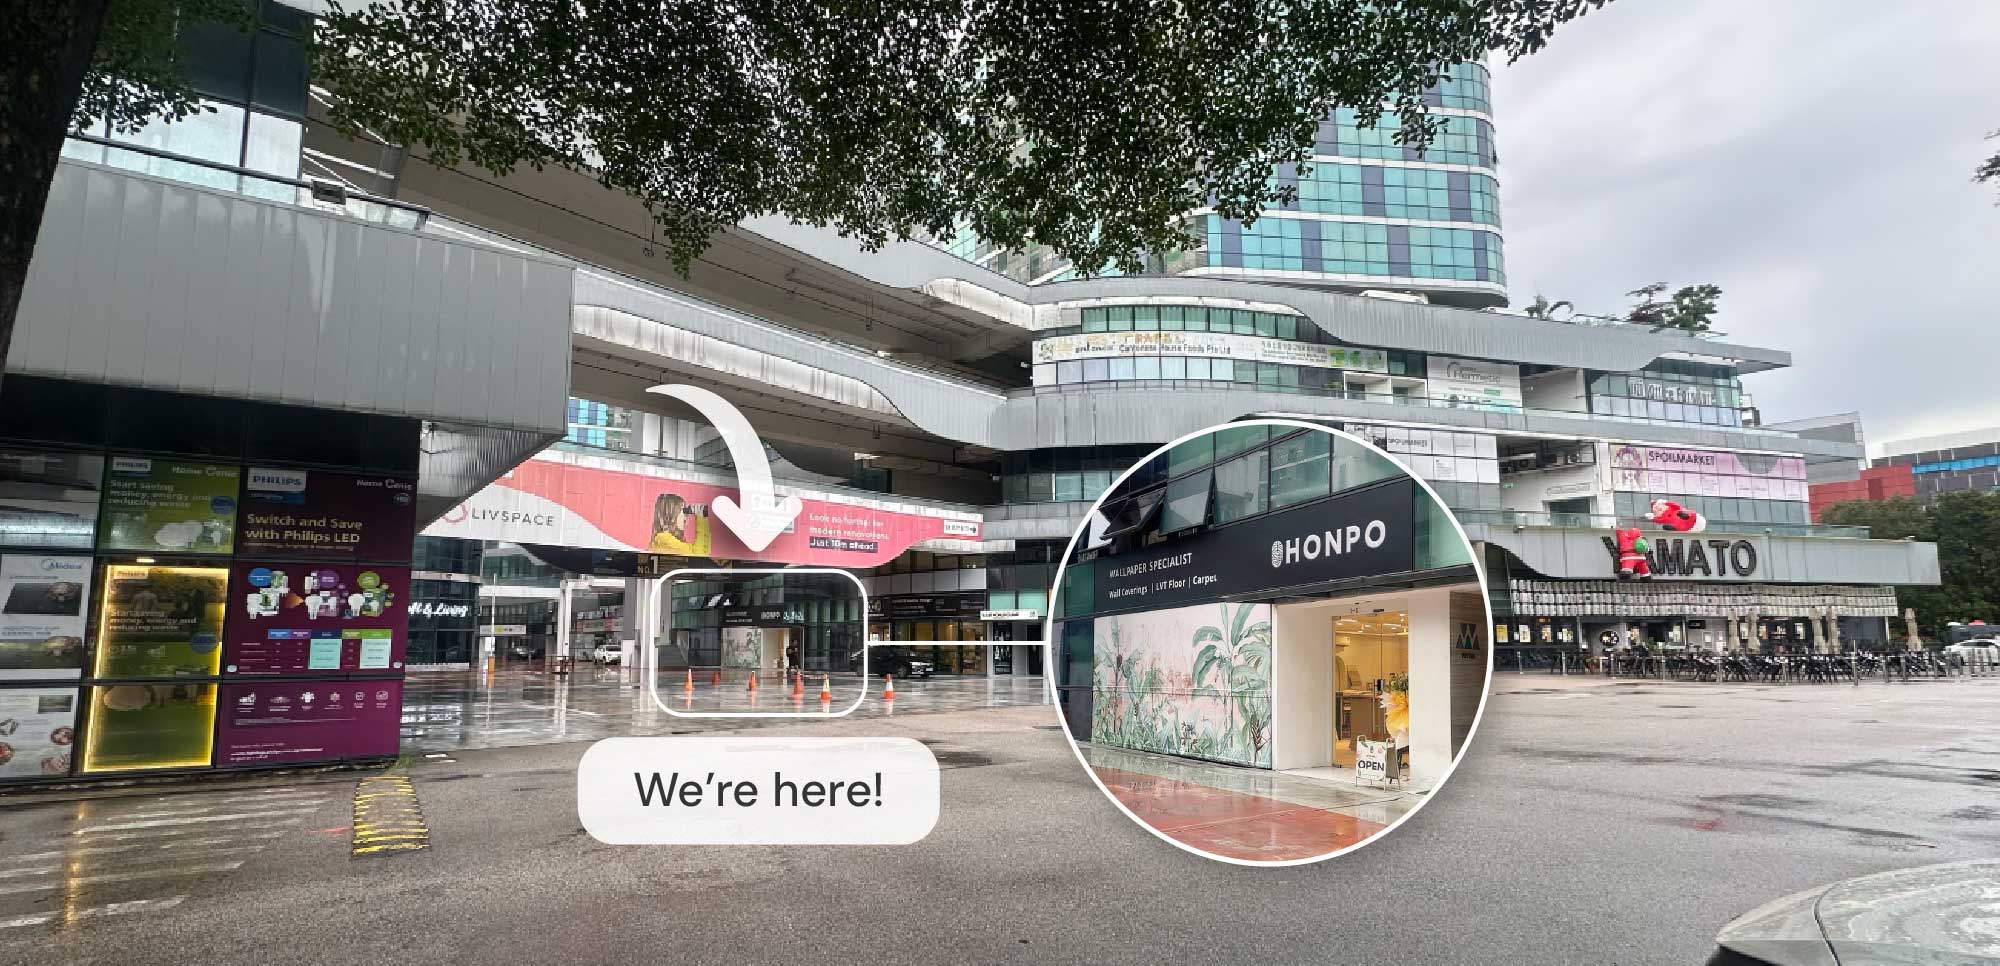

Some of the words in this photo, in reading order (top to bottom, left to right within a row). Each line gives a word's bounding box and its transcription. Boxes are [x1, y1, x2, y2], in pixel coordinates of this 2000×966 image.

[1160, 343, 1182, 352] House
[1649, 449, 1716, 466] SPOILMARKET
[110, 480, 137, 490] Start
[140, 481, 174, 492] saving
[253, 474, 302, 486] PHILIPS
[356, 479, 383, 488] Home
[385, 478, 413, 491] Genie
[247, 513, 296, 527] Switch
[300, 516, 327, 528] and
[330, 518, 363, 531] Save
[471, 507, 555, 527] LIVSPACE
[809, 512, 829, 523] Look
[246, 528, 280, 541] with
[284, 530, 331, 544] Philips
[334, 533, 361, 544] LED
[809, 526, 842, 537] modern
[810, 537, 829, 548] Just
[1285, 519, 1387, 564] HONPO
[1109, 559, 1147, 579] WALLPAPER
[1148, 552, 1193, 572] SPECIALIST
[1109, 589, 1121, 599] Wall
[1121, 585, 1148, 598] Coverings
[1156, 580, 1168, 591] LVT
[1168, 577, 1186, 590] Floor
[1192, 573, 1217, 587] Carpet
[434, 602, 470, 618] Living
[1357, 759, 1385, 771] OPEN
